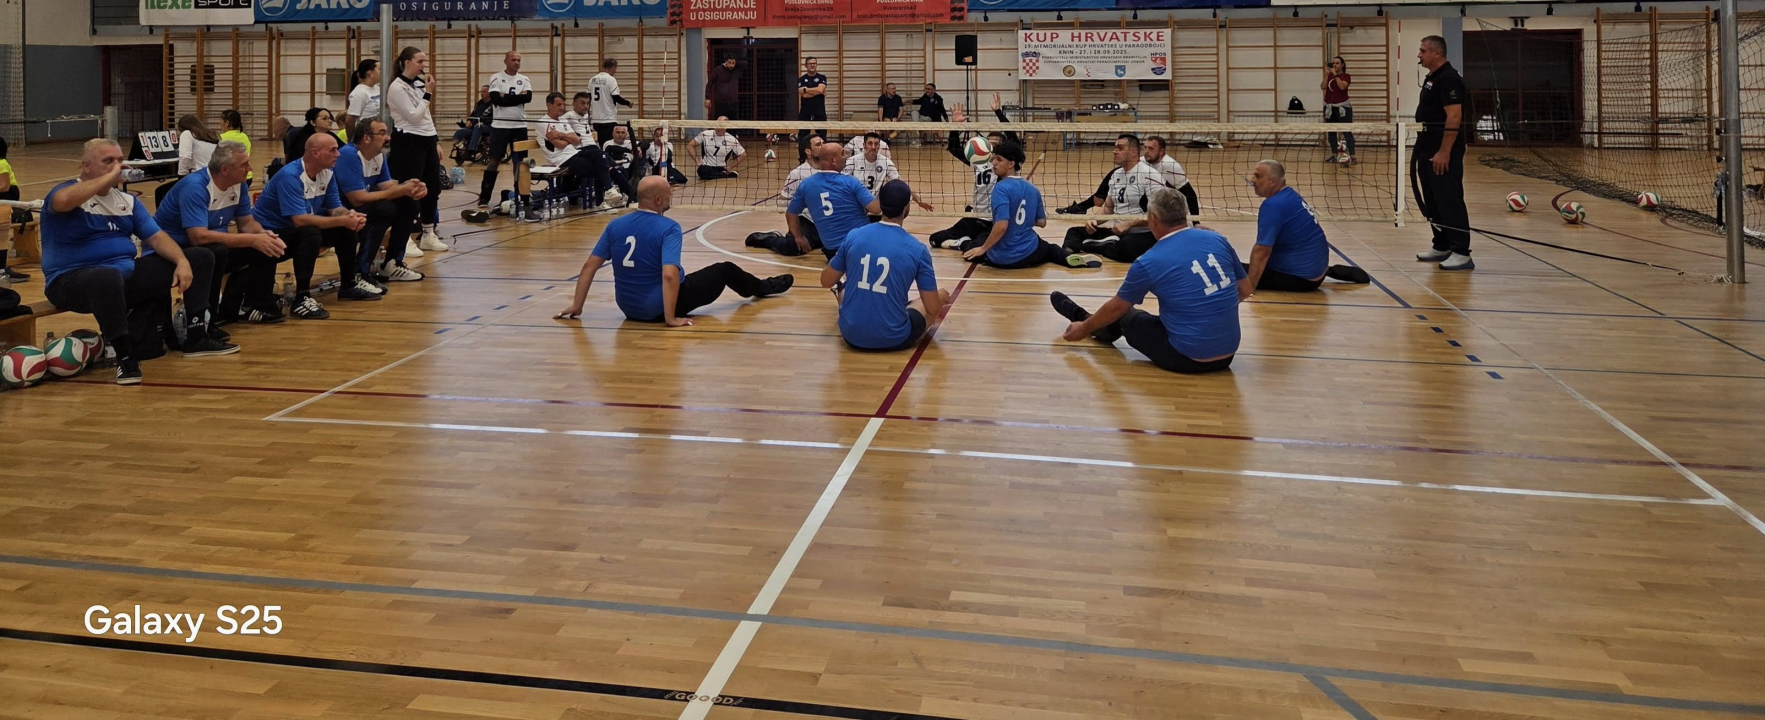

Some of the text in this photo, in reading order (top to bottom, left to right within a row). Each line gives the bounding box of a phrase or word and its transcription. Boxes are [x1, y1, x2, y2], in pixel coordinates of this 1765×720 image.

[400, 1, 509, 11] OSIGURANJE
[690, 0, 757, 9] ZASTUPANJE
[690, 11, 757, 20] U OSIGURANJU
[1024, 31, 1165, 43] KUP HRVATSKE
[594, 87, 600, 101] 5
[141, 133, 177, 148] 1 13 8 0
[713, 145, 720, 156] 7
[867, 176, 875, 190] 3
[977, 169, 992, 185] 16
[1118, 188, 1126, 203] 8
[820, 192, 834, 216] 5
[1015, 199, 1027, 225] 6
[622, 235, 636, 268] 2
[858, 253, 890, 294] 12
[1191, 253, 1231, 296] 11
[675, 692, 734, 705] GOOOD
